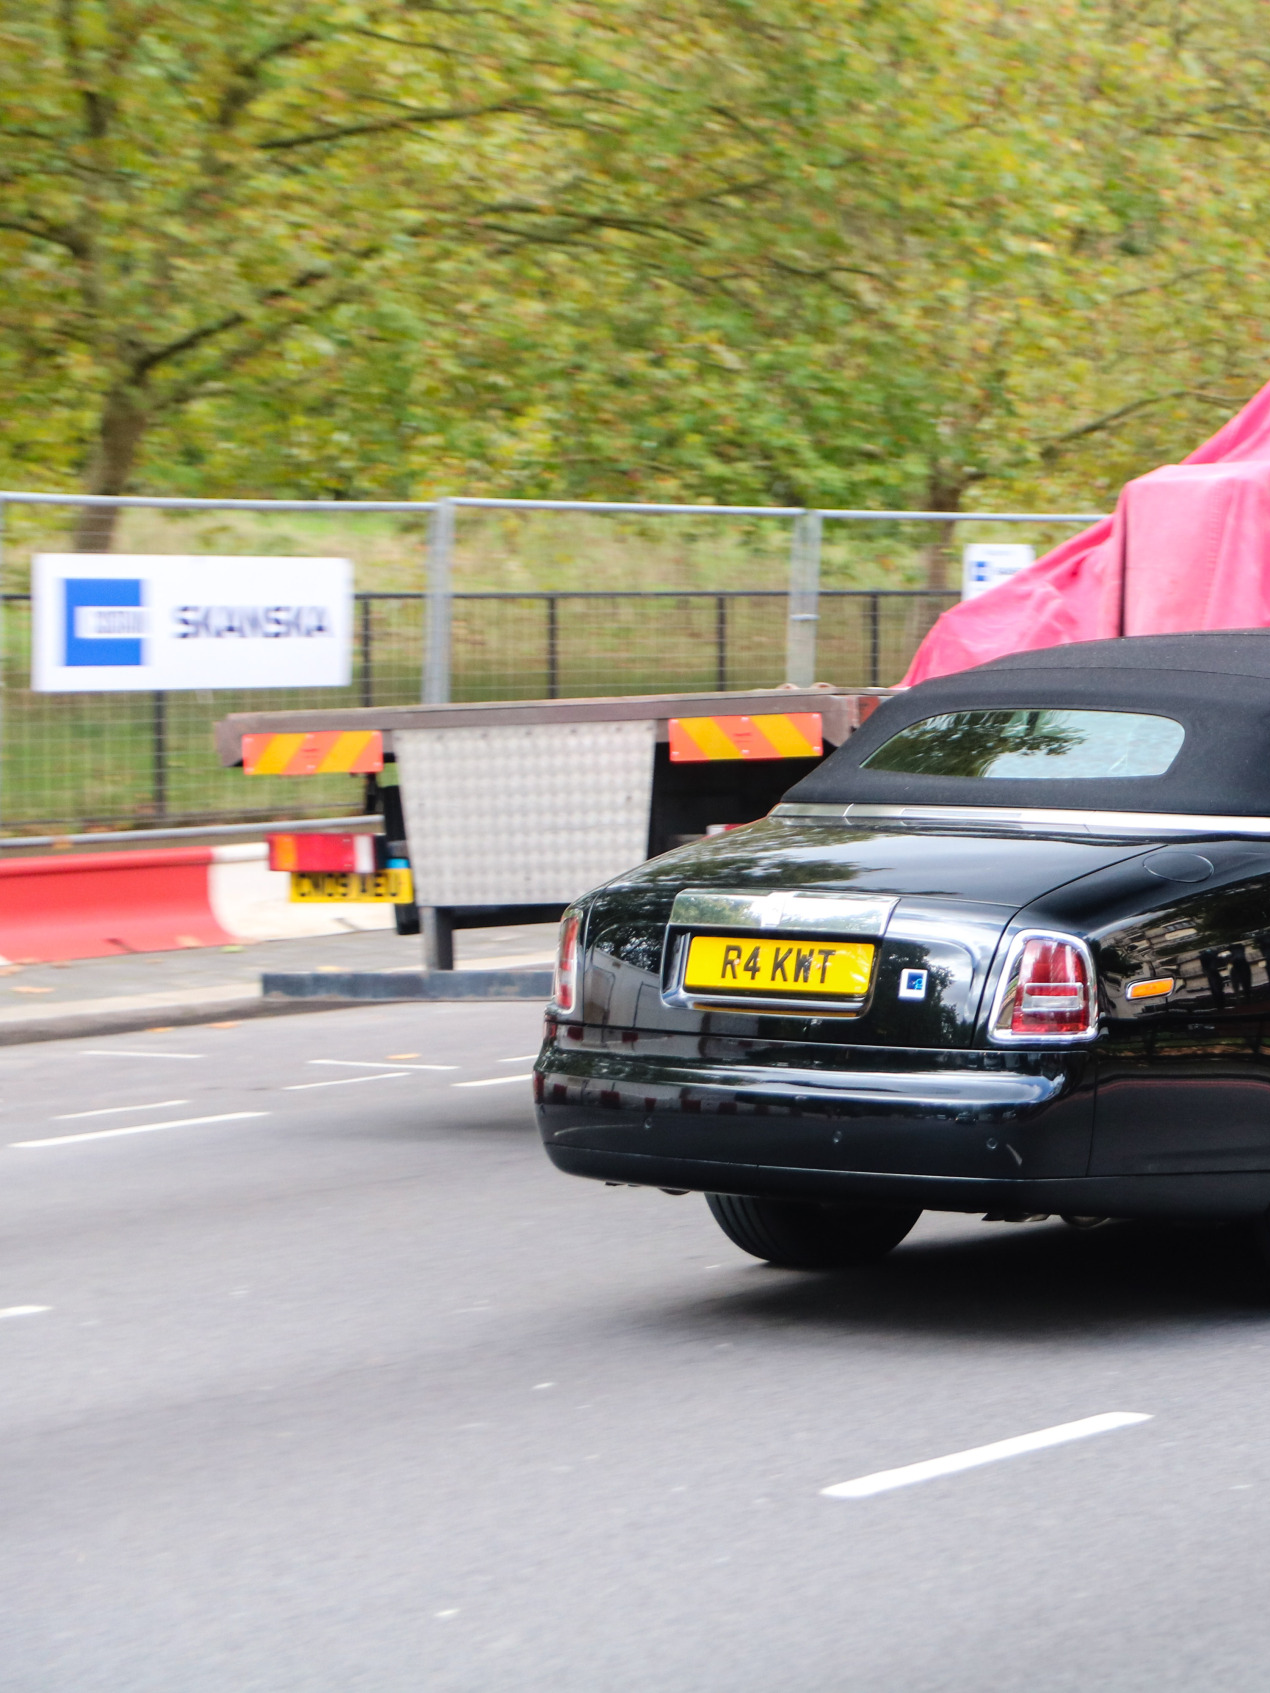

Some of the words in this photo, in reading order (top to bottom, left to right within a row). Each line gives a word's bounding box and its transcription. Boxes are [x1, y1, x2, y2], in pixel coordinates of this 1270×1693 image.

[172, 604, 335, 639] SKANSKA
[720, 944, 762, 981] R4
[770, 946, 837, 985] KWT
